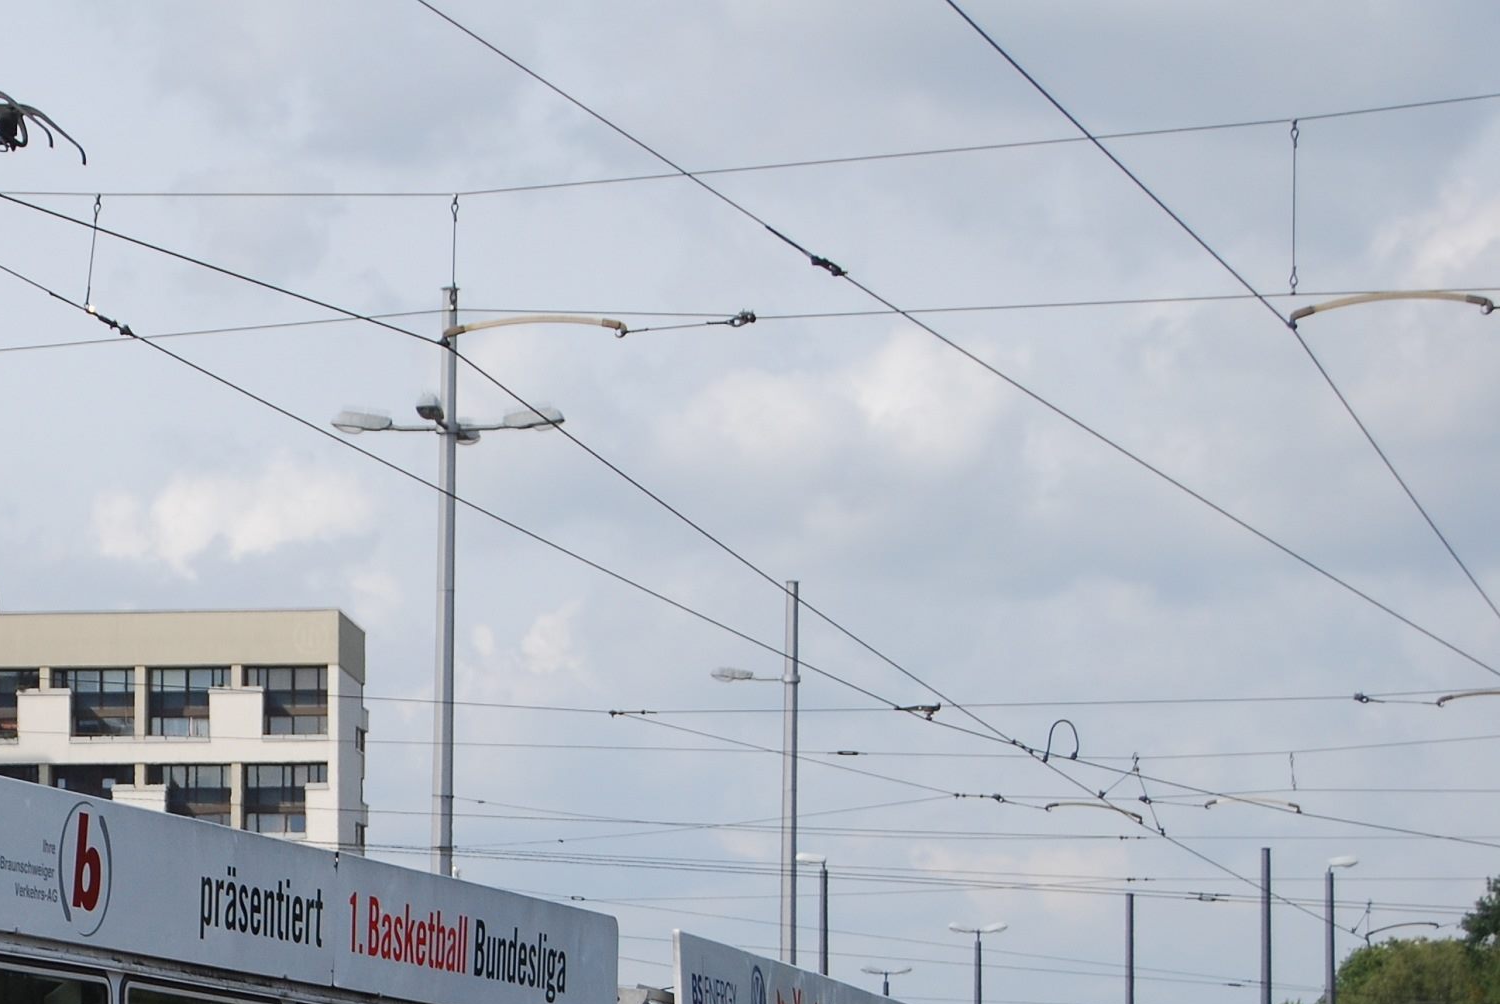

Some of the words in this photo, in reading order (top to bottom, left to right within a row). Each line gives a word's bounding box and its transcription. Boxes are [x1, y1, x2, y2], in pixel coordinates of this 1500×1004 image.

[42, 839, 56, 855] Ihre
[0, 855, 56, 880] Braunschweiger
[14, 882, 59, 903] Verkehrs-AG
[200, 866, 324, 948] präsentiert
[474, 919, 567, 1003] Bundesliga
